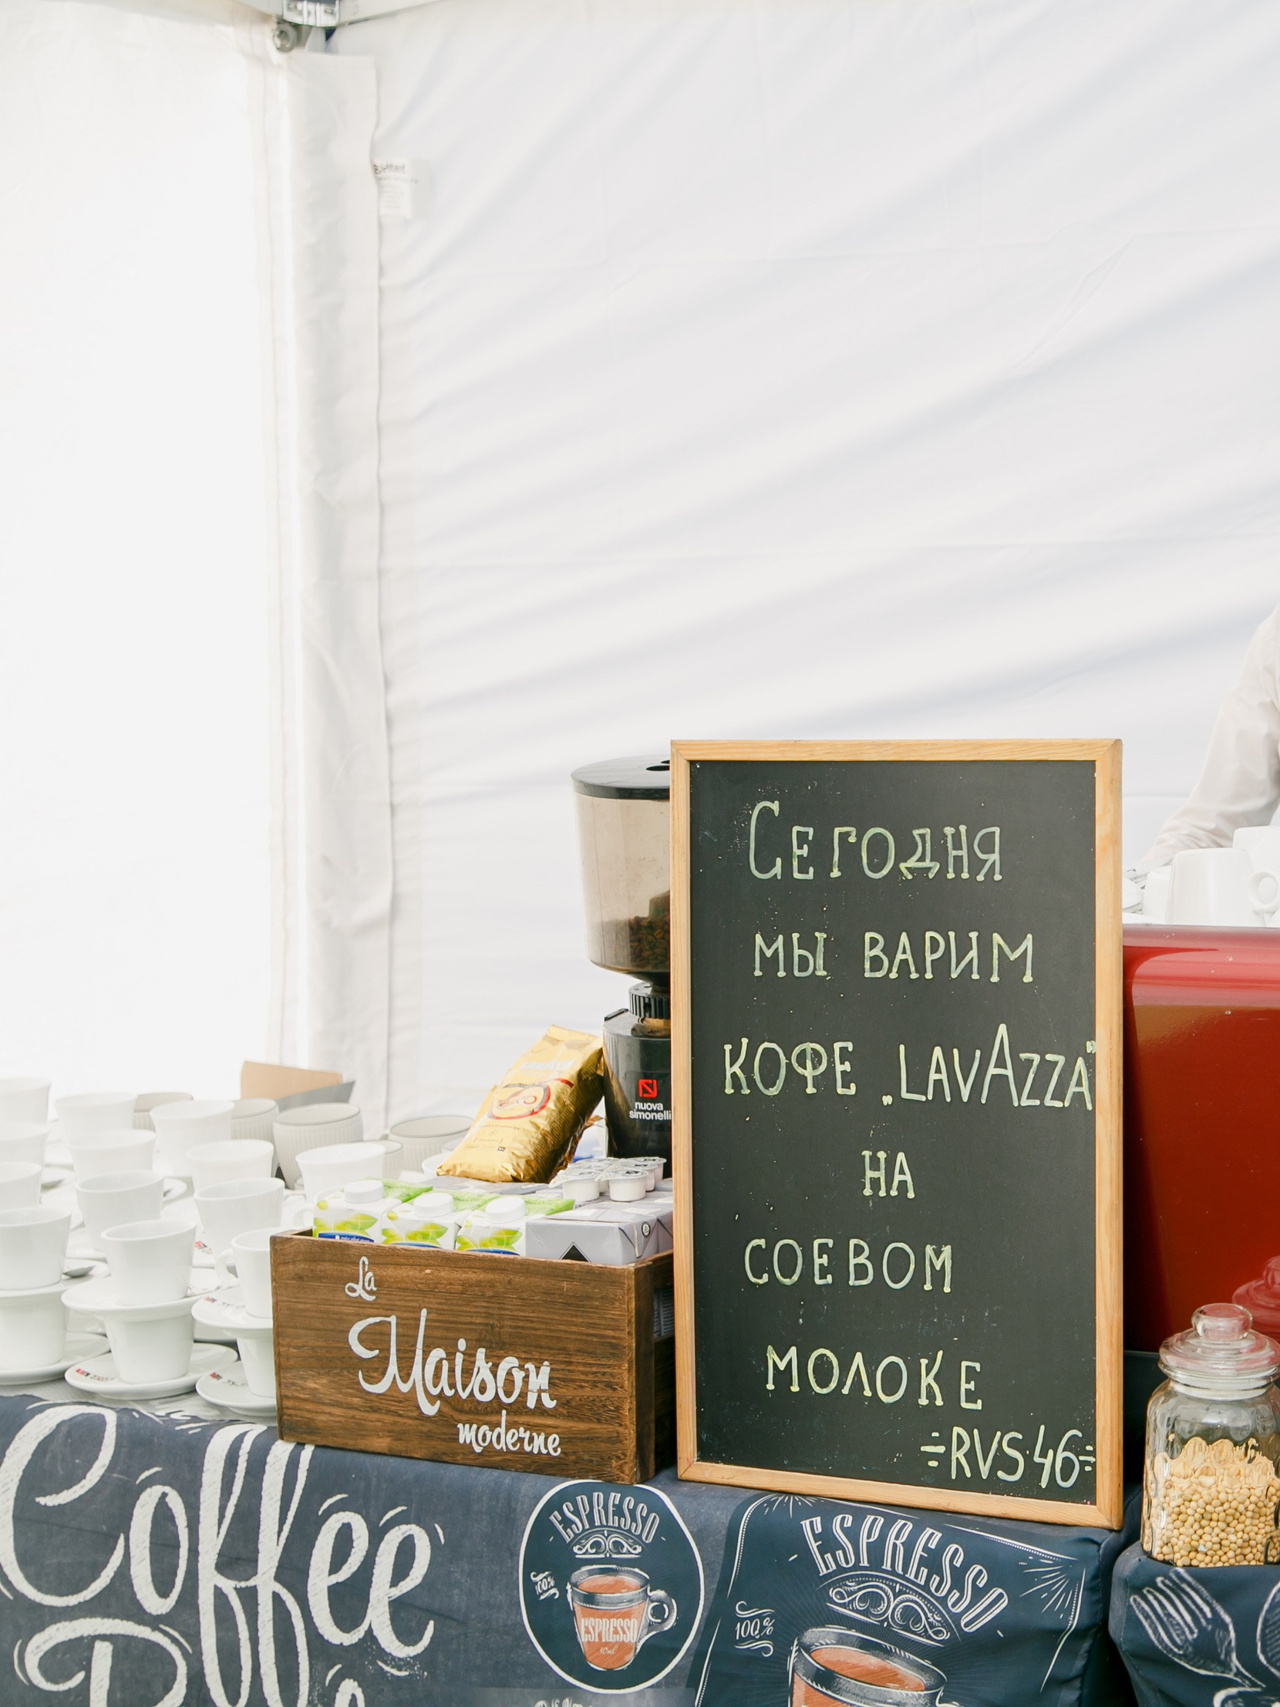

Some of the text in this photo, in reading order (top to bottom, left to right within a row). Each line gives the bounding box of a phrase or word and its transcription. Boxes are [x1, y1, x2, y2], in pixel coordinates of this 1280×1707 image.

[753, 930, 1034, 984] МЫ ВАРИМ
[723, 1037, 857, 1096] КОФЕ
[628, 1109, 672, 1121] simonelli
[634, 1101, 664, 1111] nuova
[861, 1149, 916, 1200] НА
[344, 1255, 378, 1302] La
[743, 1238, 953, 1294] СОЕВОМ
[347, 1307, 558, 1417] Maison
[765, 1344, 984, 1412] МОЛОКЕ
[456, 1409, 562, 1457] moderne
[548, 1491, 661, 1545] ESPRESSO
[0, 1404, 437, 1707] Coffee
[800, 1513, 1009, 1634] ESPRESSO
[534, 1576, 556, 1596] 100%
[580, 1617, 639, 1644] ESPRESSO
[733, 1617, 777, 1641] 100%
